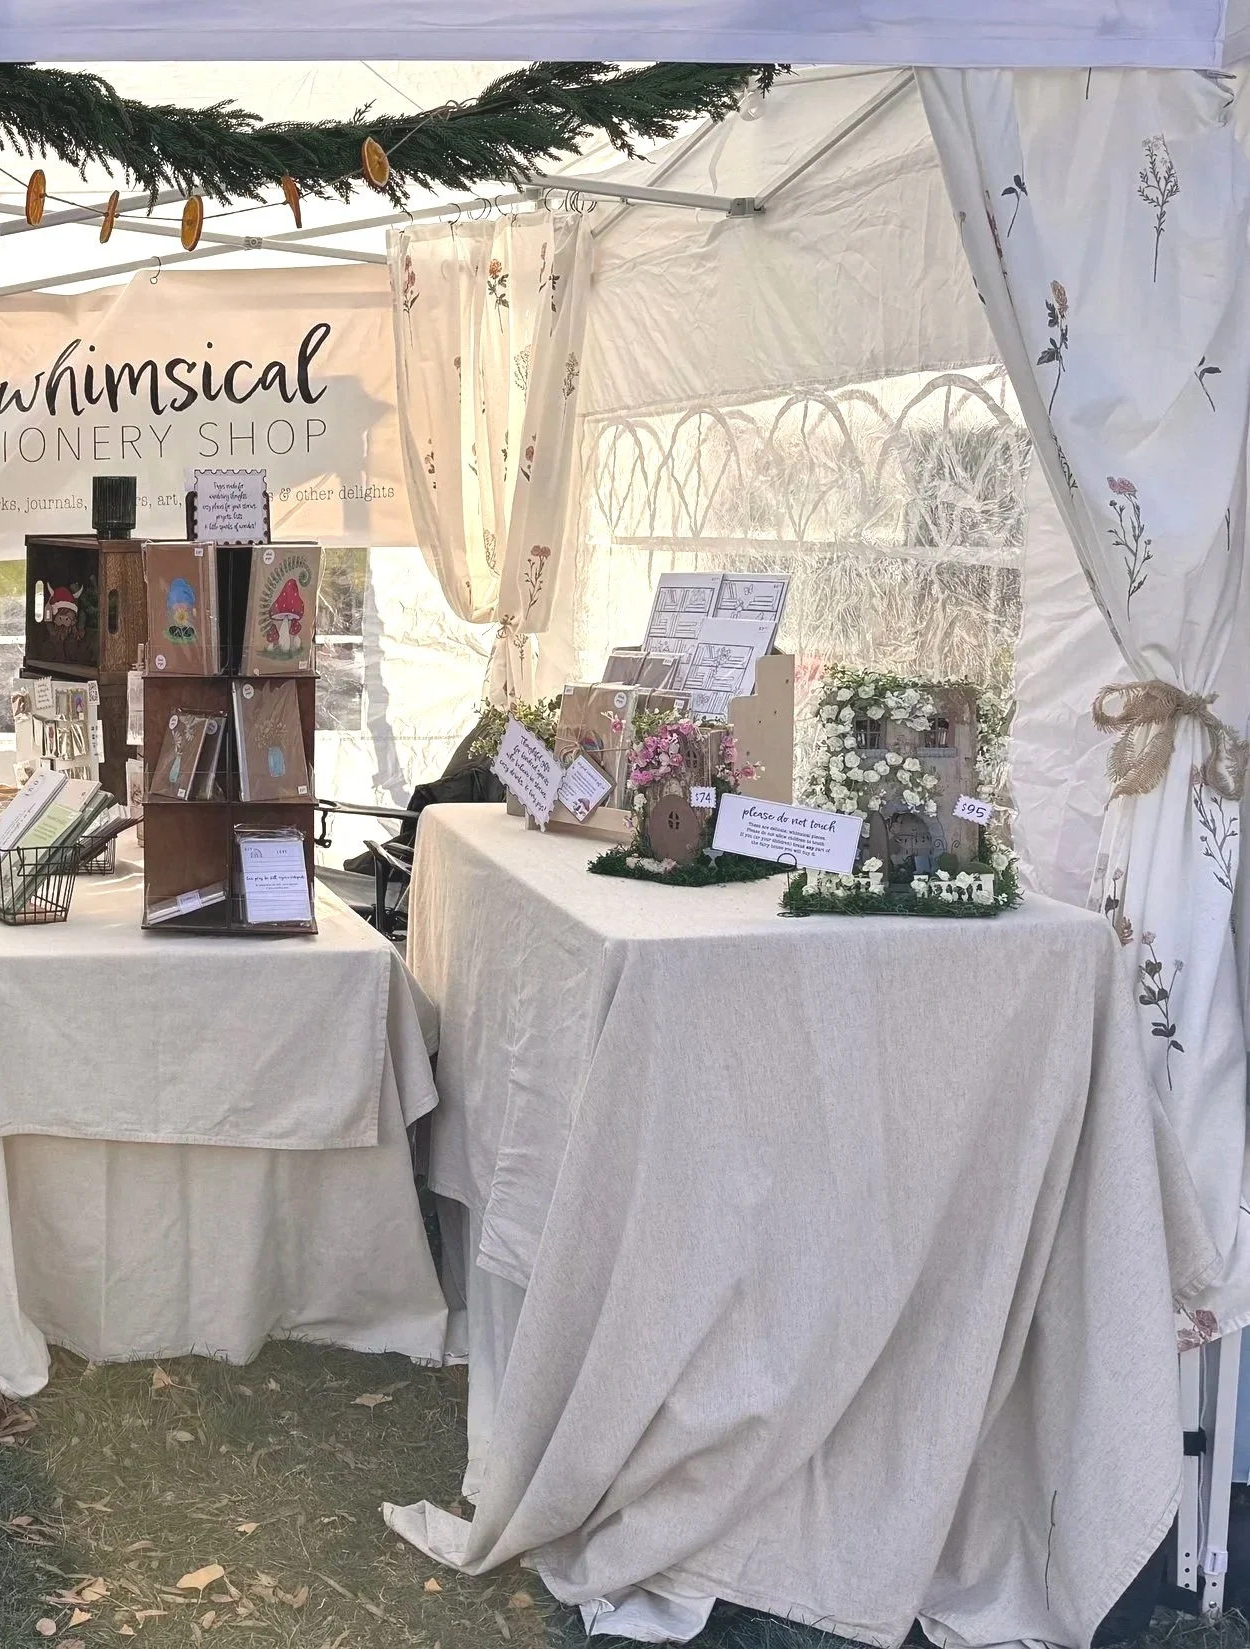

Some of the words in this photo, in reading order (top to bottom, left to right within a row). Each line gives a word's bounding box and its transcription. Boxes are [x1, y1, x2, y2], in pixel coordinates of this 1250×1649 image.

[198, 418, 328, 458] SHOP
[24, 495, 88, 513] journals,
[157, 494, 182, 509] art,
[279, 488, 292, 501] &
[295, 486, 334, 501] other
[338, 484, 395, 502] delights
[695, 792, 711, 803] $74
[961, 802, 987, 818] $95
[742, 806, 775, 820] please
[777, 811, 789, 823] do
[791, 818, 807, 828] not
[810, 820, 837, 833] touch
